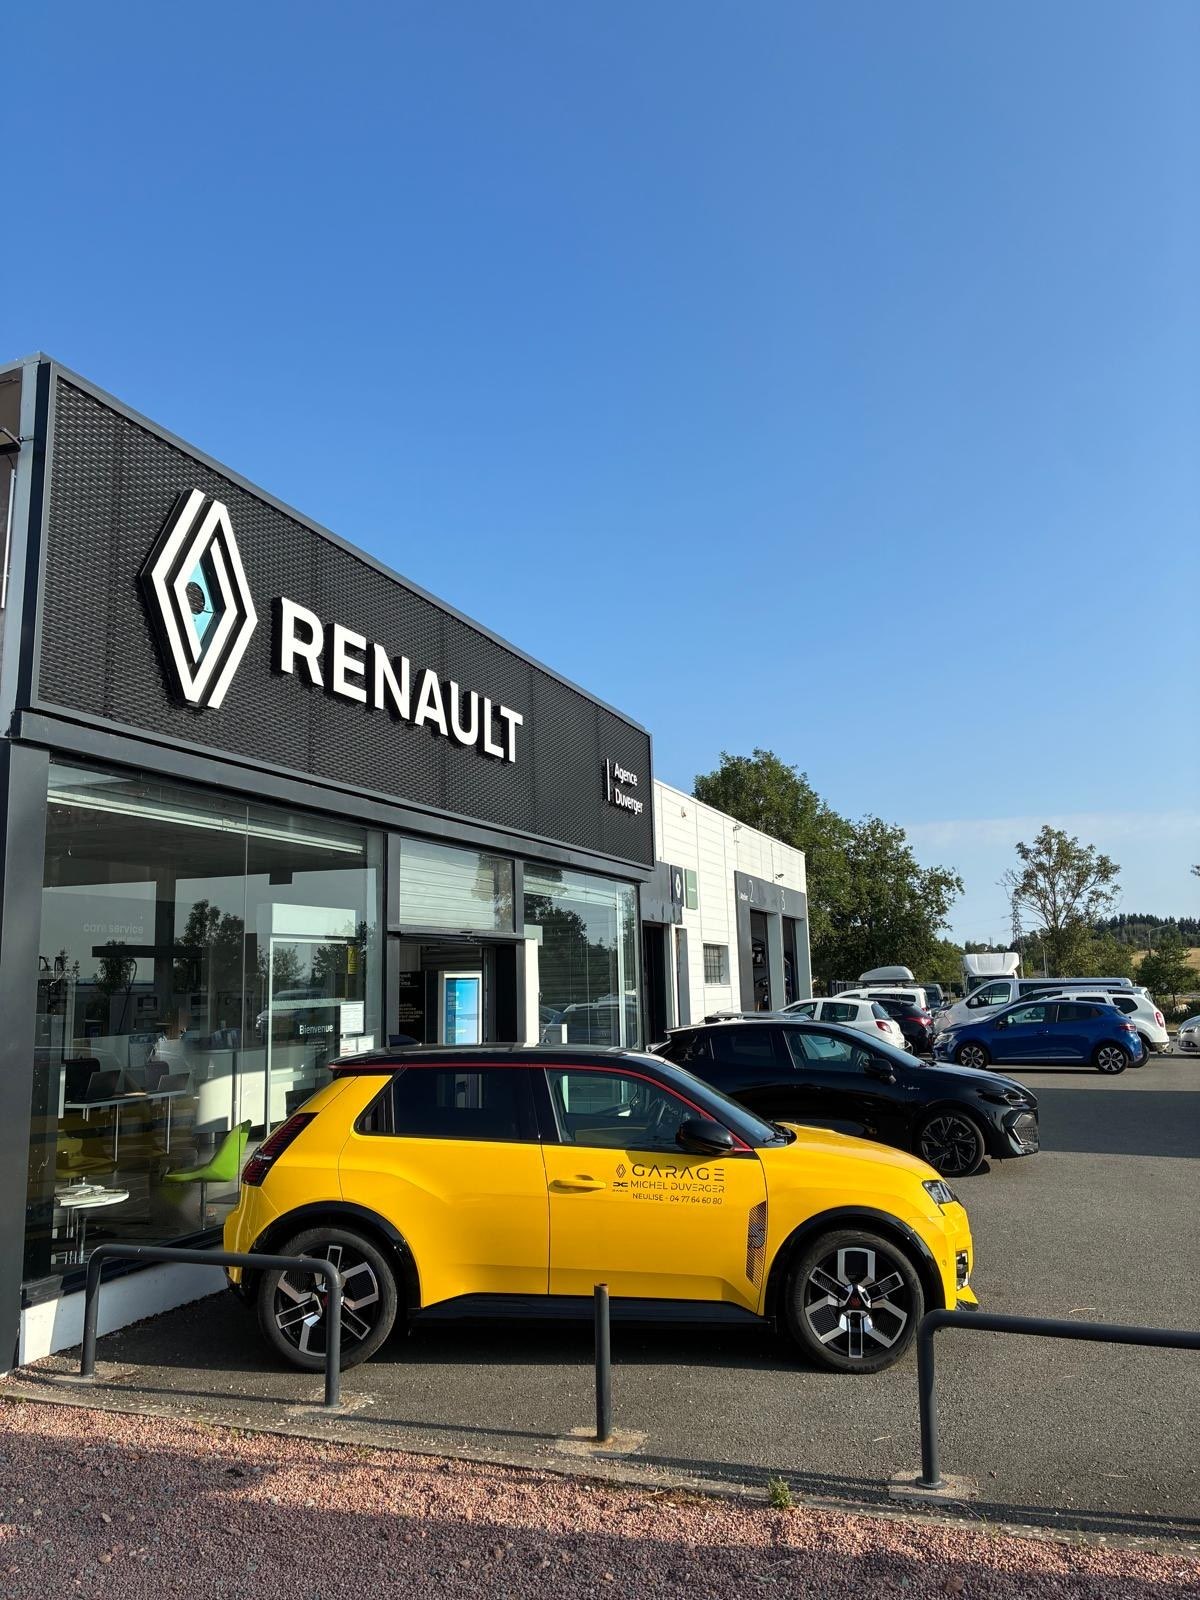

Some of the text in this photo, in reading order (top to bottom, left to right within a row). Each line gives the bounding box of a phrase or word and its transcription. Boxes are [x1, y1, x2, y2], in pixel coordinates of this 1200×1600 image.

[281, 596, 523, 762] RENAULT
[615, 762, 638, 786] Agence
[615, 788, 643, 815] Duverger
[748, 879, 754, 903] 2
[781, 889, 786, 910] 3
[108, 922, 144, 935] service
[299, 1024, 334, 1035] Bienvenue
[631, 1163, 725, 1182] GARAGE
[630, 1180, 725, 1193] MICHEL DUVERGER
[632, 1192, 664, 1202] NEULISE
[669, 1194, 680, 1202] 04
[681, 1195, 690, 1203] 77
[691, 1196, 700, 1204] 64
[702, 1196, 712, 1204] 60
[713, 1197, 723, 1205] 80
